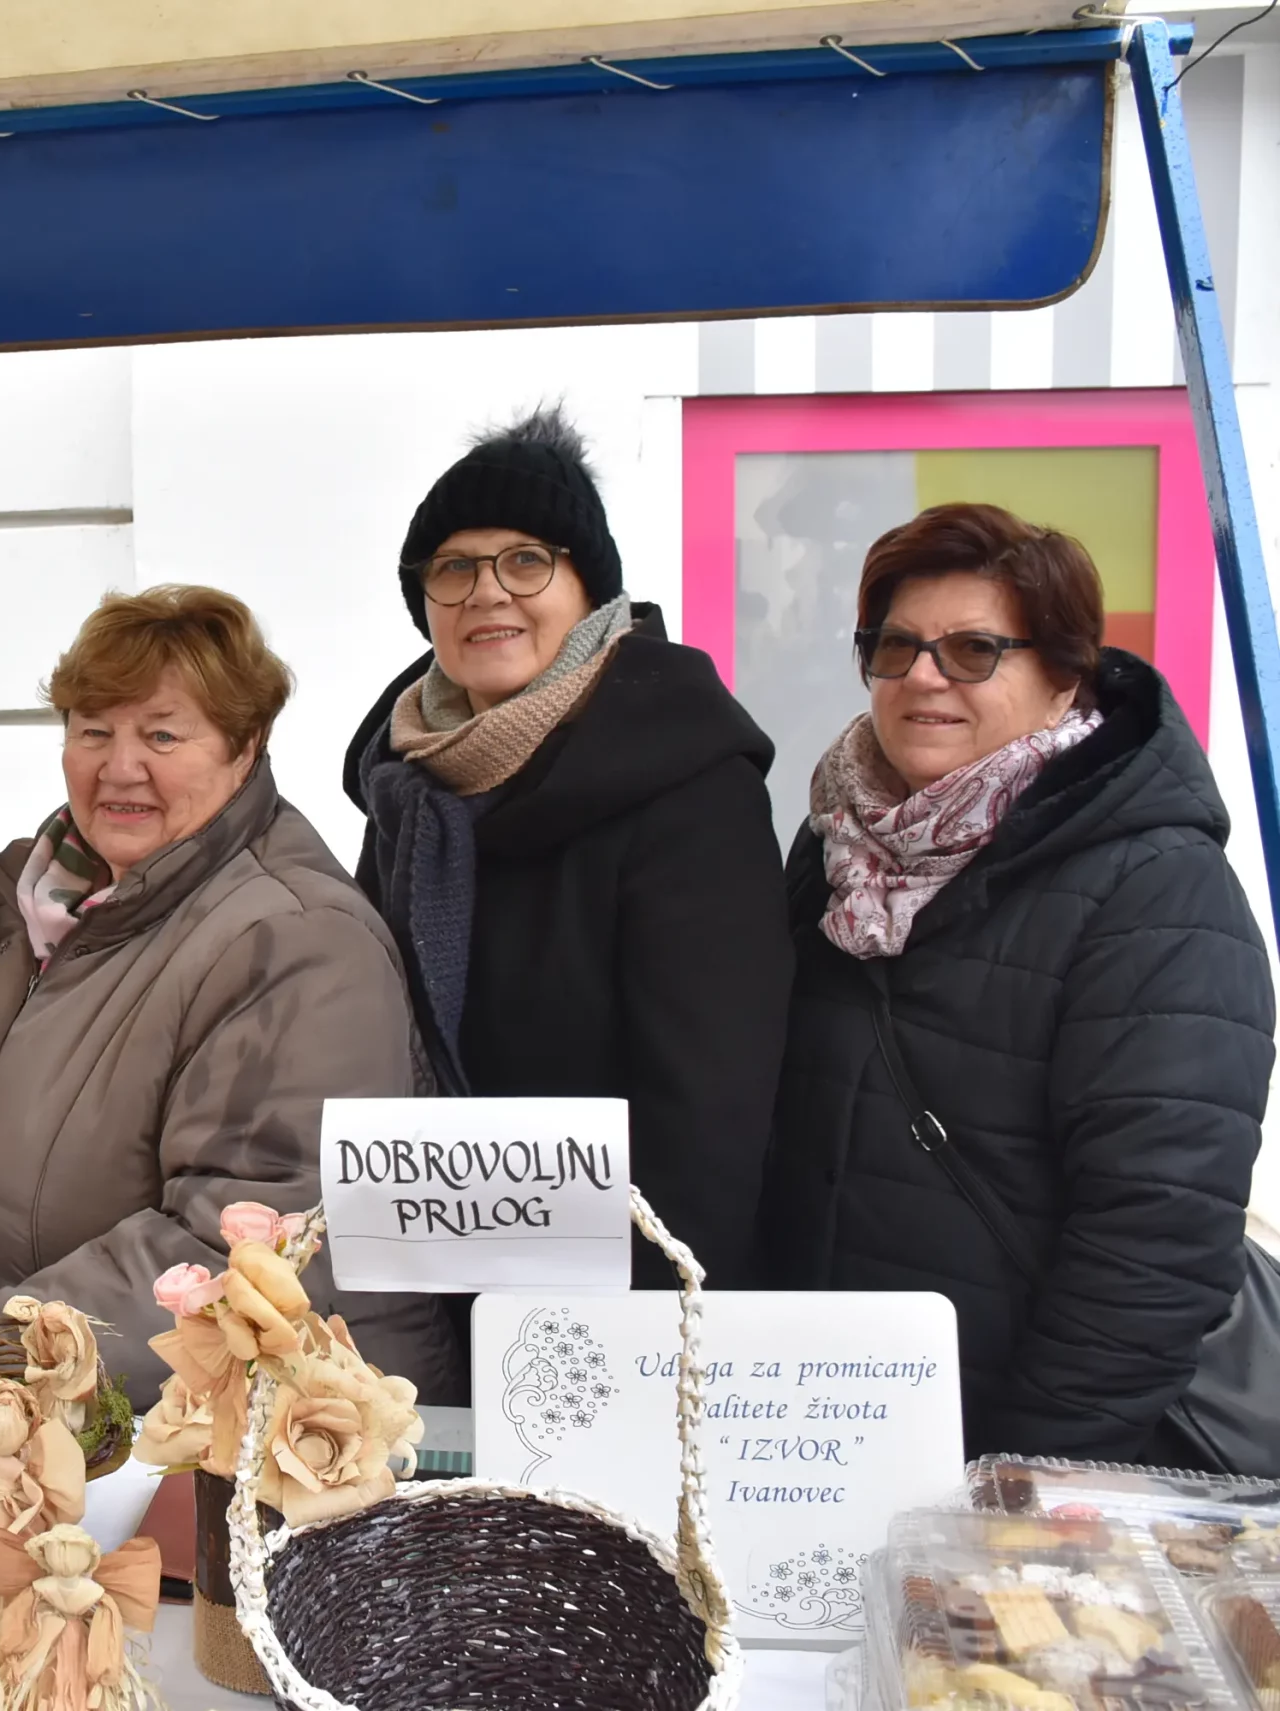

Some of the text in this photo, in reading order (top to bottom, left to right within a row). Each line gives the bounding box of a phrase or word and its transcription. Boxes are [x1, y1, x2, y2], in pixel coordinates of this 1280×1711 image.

[335, 1136, 614, 1191] DOBROVOLJNI
[391, 1197, 553, 1237] PRILOG
[634, 1351, 938, 1387] Udga za promicanje
[804, 1396, 888, 1420] života
[726, 1480, 846, 1504] Ivanovec
